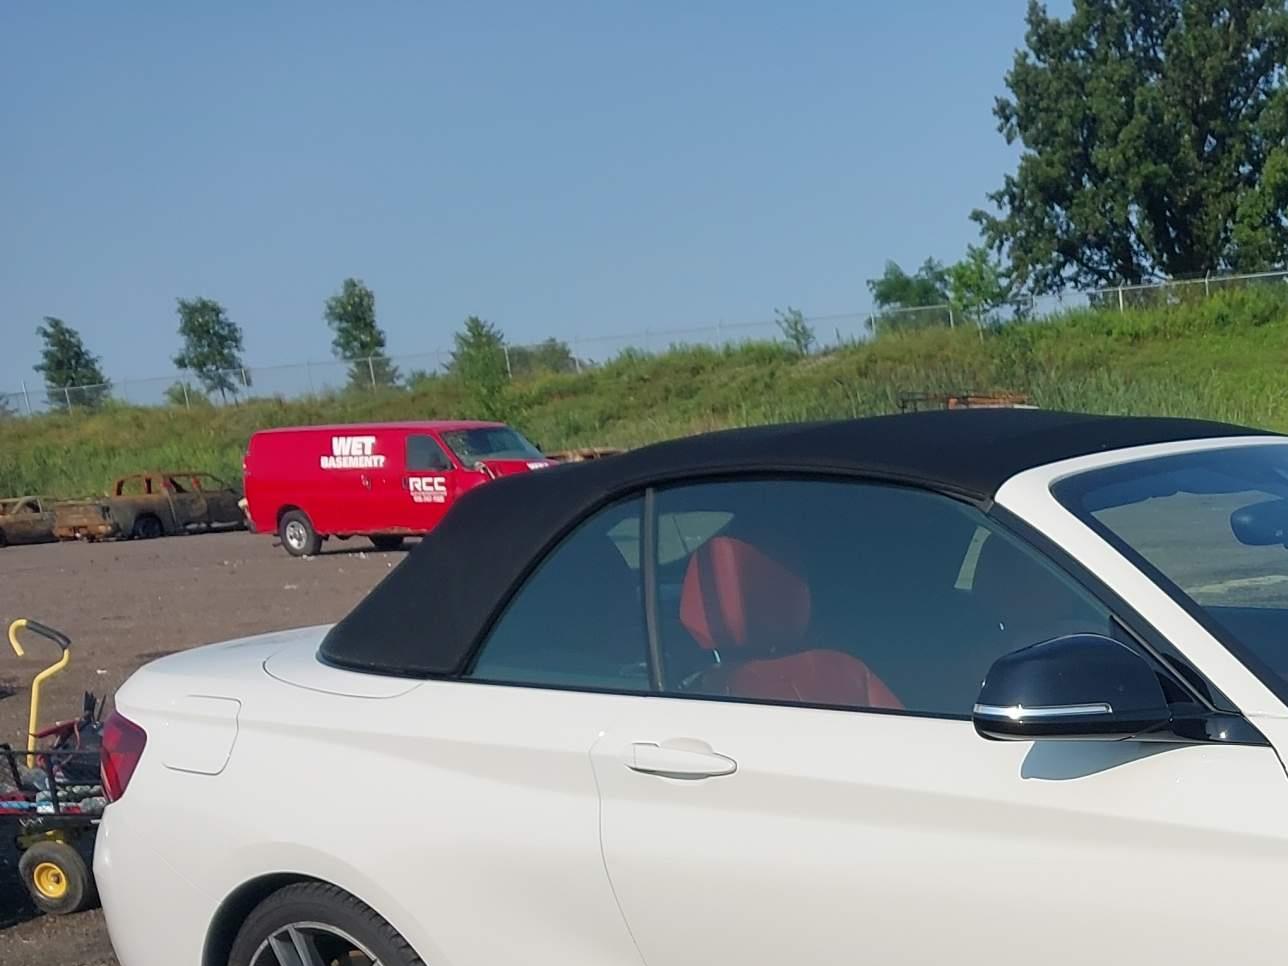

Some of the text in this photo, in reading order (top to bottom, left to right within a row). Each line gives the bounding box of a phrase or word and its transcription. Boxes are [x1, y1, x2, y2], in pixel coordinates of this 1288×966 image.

[332, 435, 377, 456] WET
[320, 454, 386, 469] BASEMENT?
[408, 476, 447, 491] RCC
